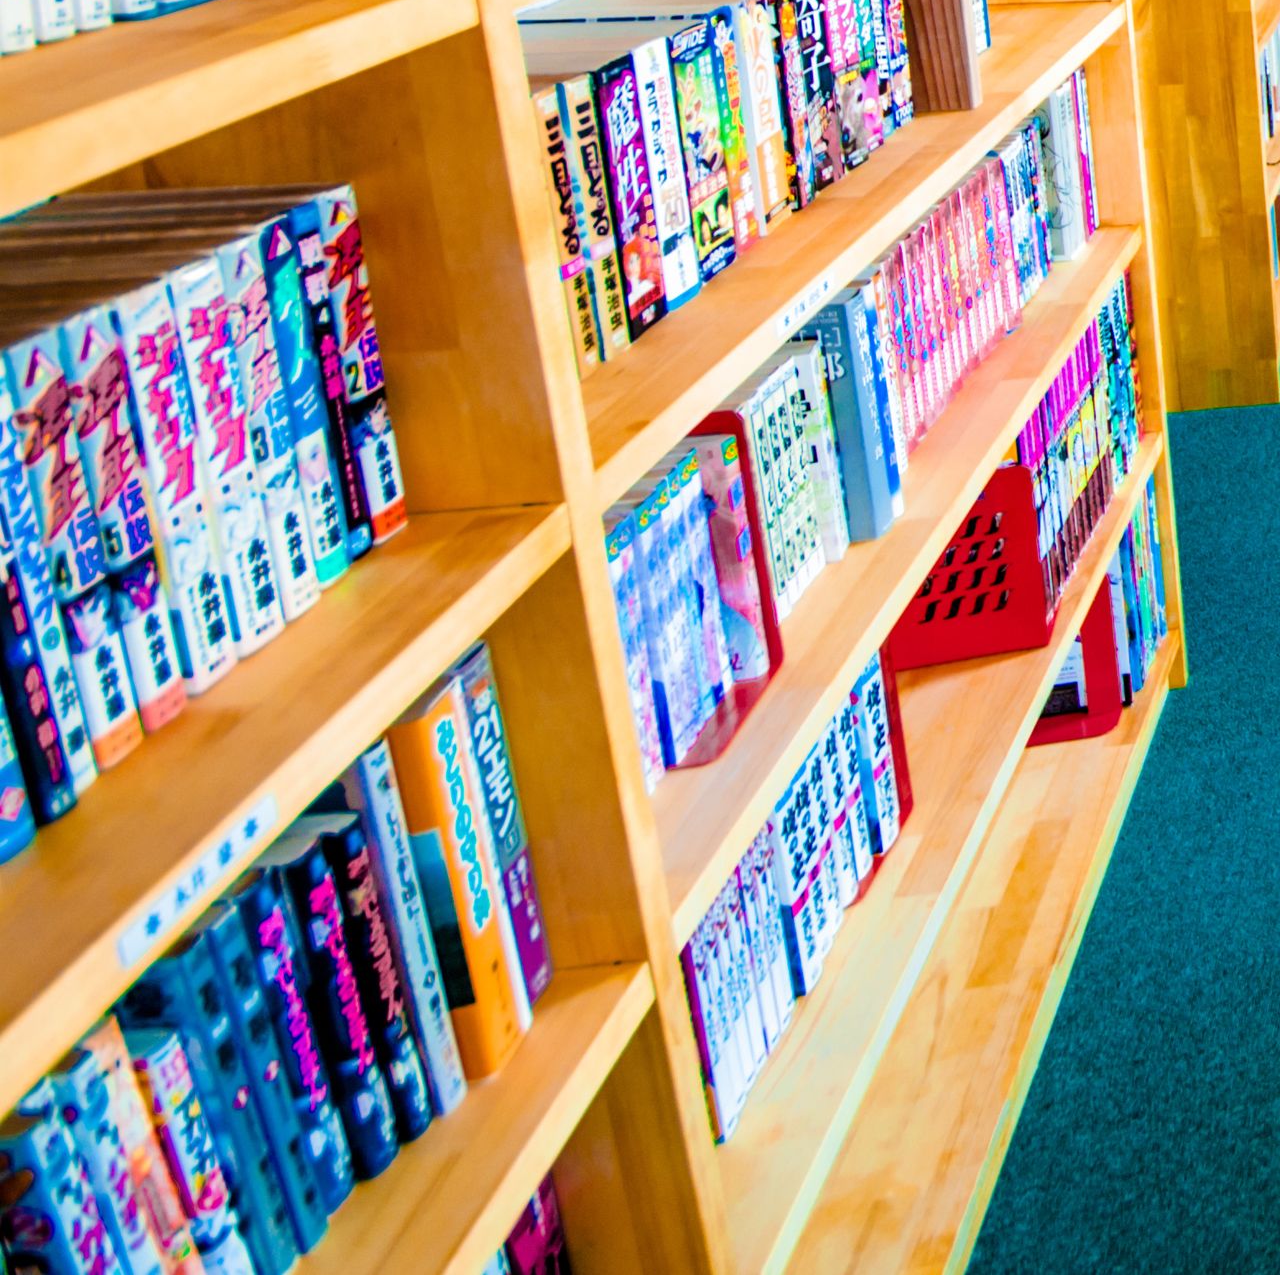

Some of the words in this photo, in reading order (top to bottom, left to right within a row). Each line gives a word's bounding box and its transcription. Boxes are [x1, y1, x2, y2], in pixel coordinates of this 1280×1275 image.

[827, 1, 843, 67] 手塚治虫
[749, 26, 776, 136] 火の鳥
[602, 255, 625, 333] 手塚治虫
[346, 359, 363, 395] 2
[375, 439, 398, 506] 永井豪
[252, 428, 268, 463] 3
[284, 509, 307, 579] 永井豪
[53, 550, 74, 593] 4
[101, 520, 123, 563] 5
[247, 539, 276, 611] 永井豪
